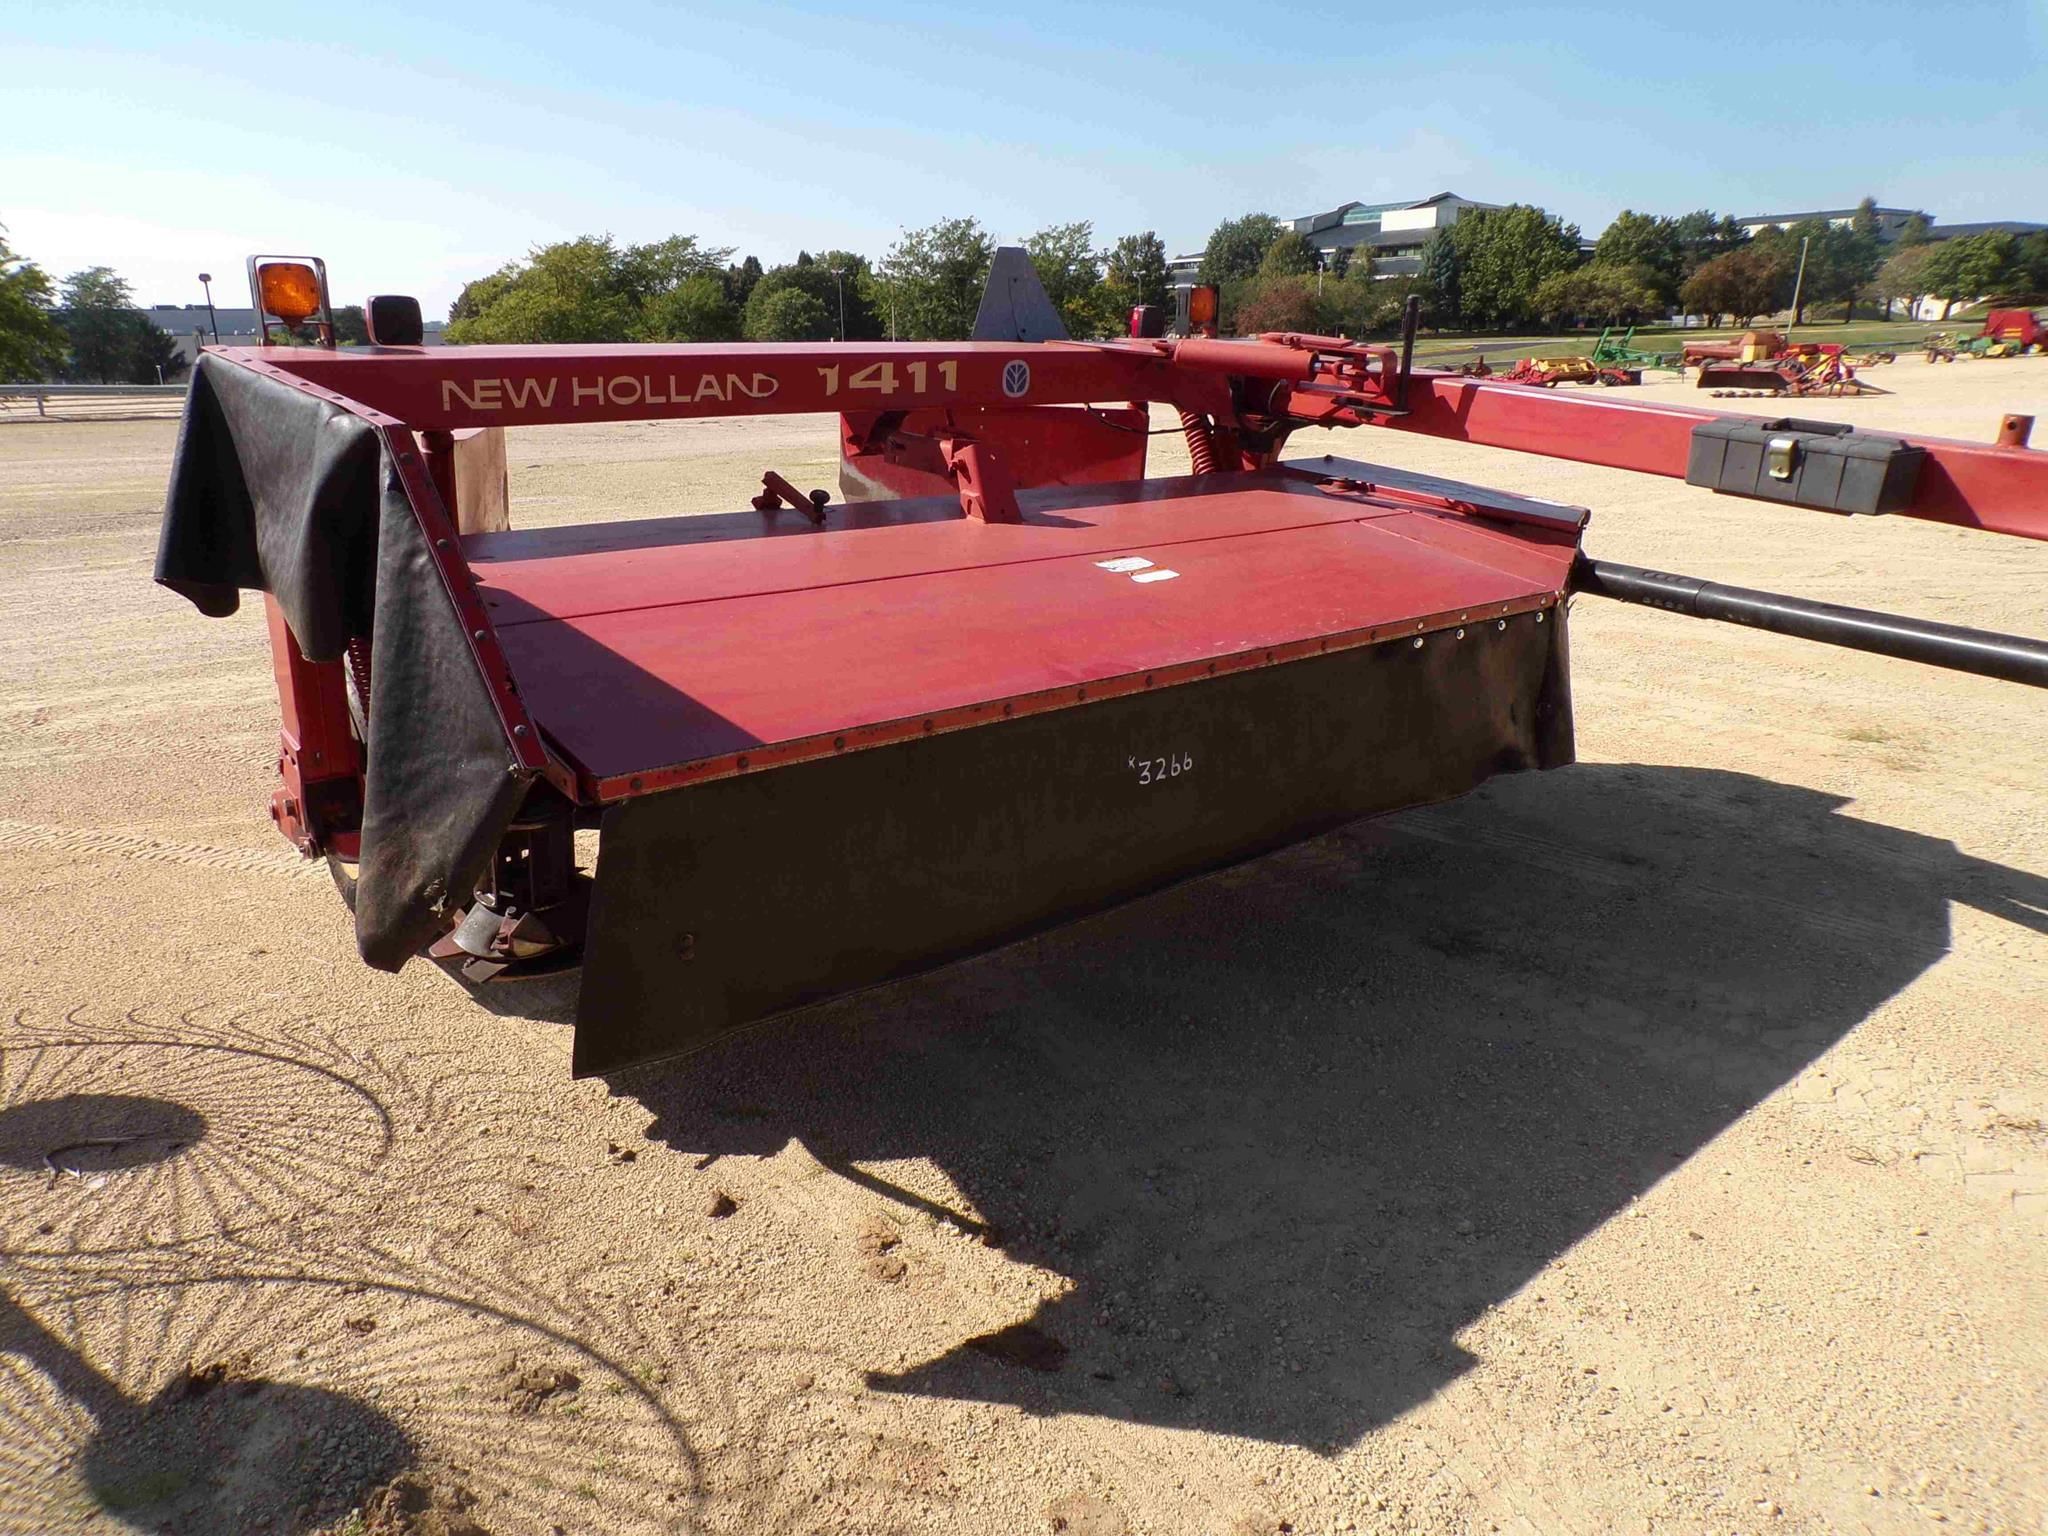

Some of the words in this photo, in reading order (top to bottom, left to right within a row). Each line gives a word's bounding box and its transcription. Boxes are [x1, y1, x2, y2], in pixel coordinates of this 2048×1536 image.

[442, 376, 558, 411] NEW
[573, 371, 779, 407] HOLLAND
[817, 360, 958, 396] 1411
